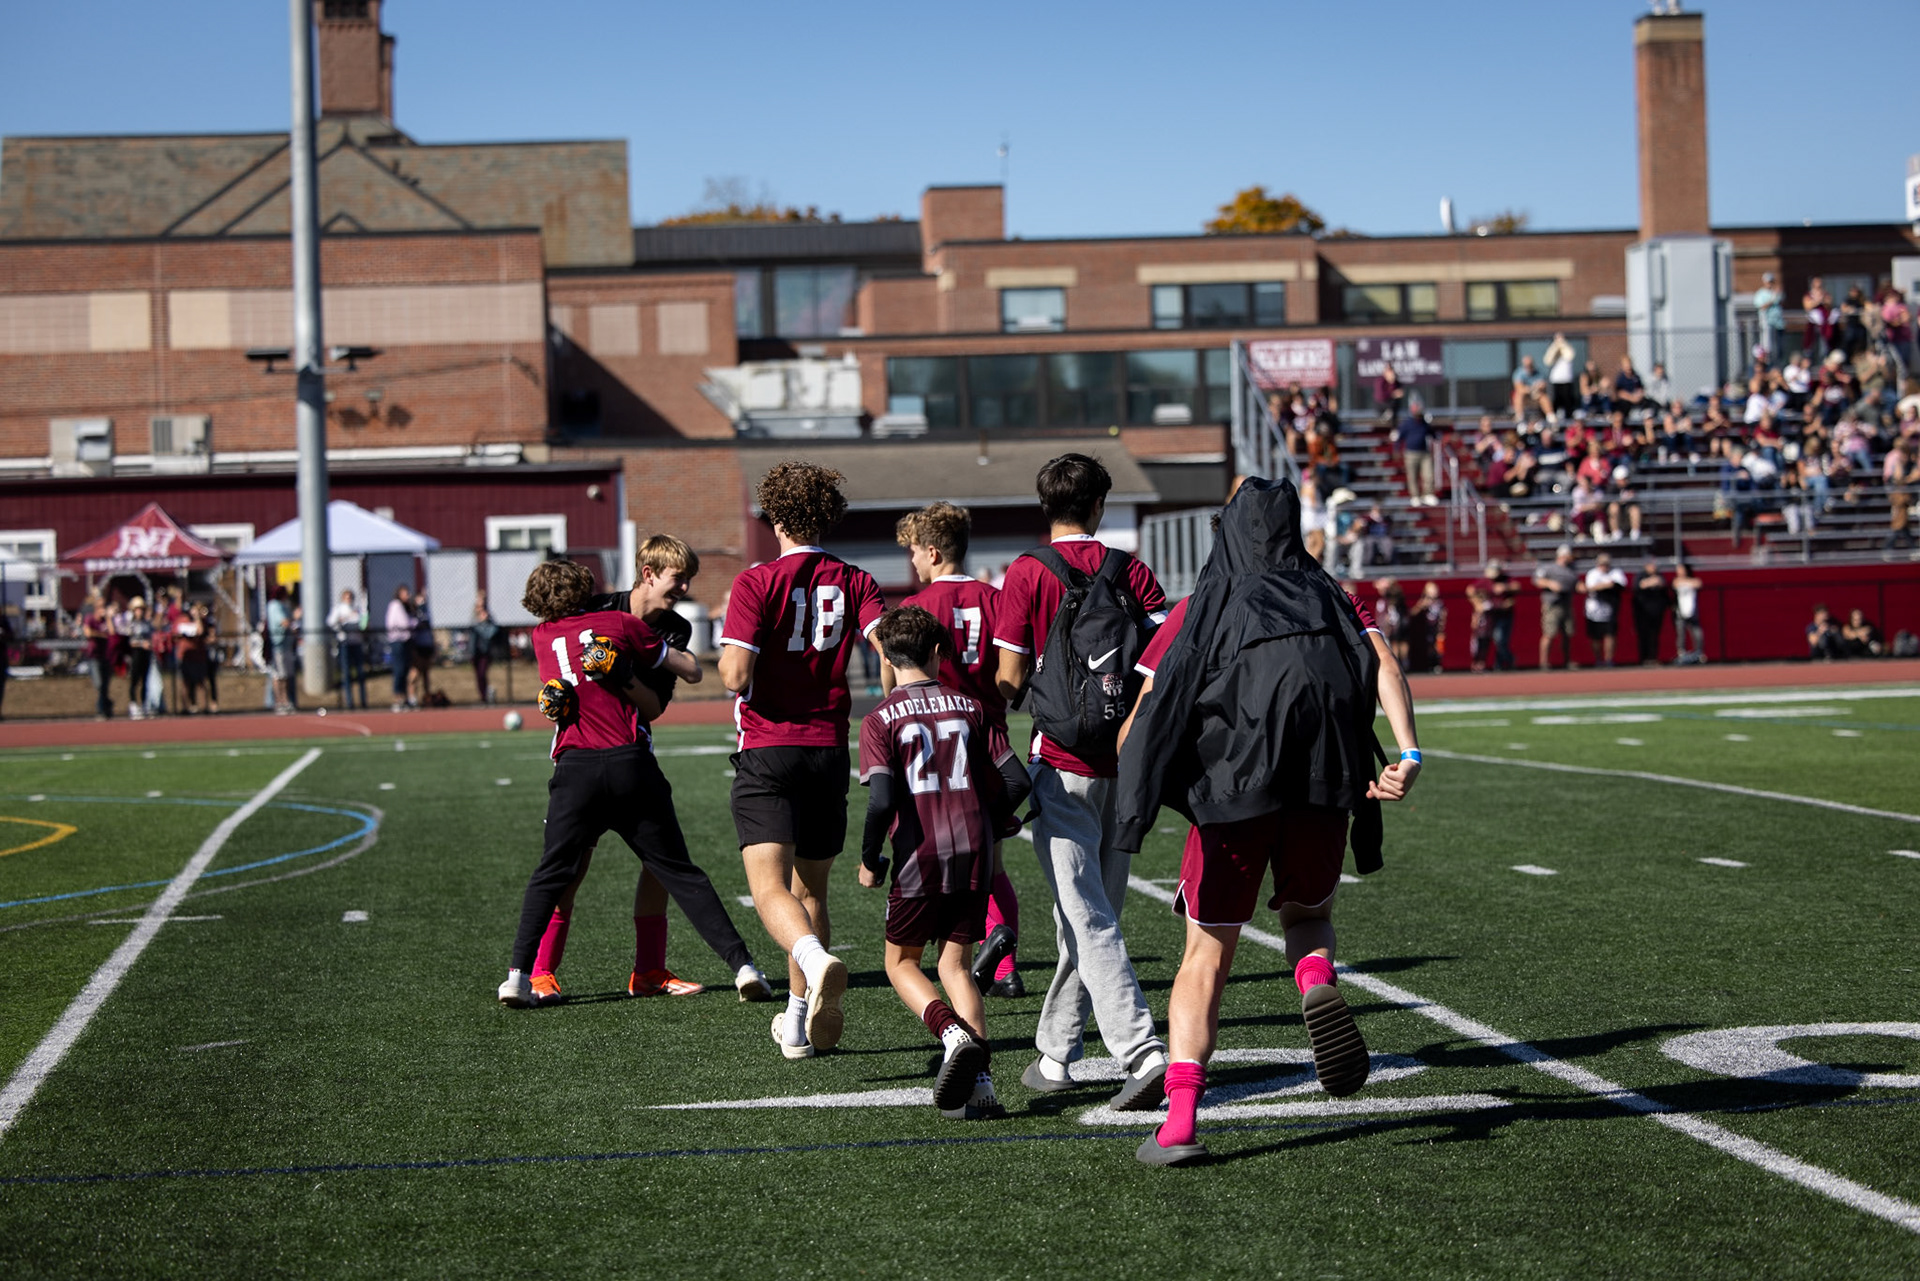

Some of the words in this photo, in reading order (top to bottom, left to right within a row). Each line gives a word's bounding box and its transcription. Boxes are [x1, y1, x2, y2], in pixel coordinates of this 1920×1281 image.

[787, 585, 844, 651] 18
[953, 607, 981, 664] 7
[878, 695, 975, 725] MANDELENAKIS
[1104, 701, 1126, 720] 55
[899, 718, 970, 795] 27
